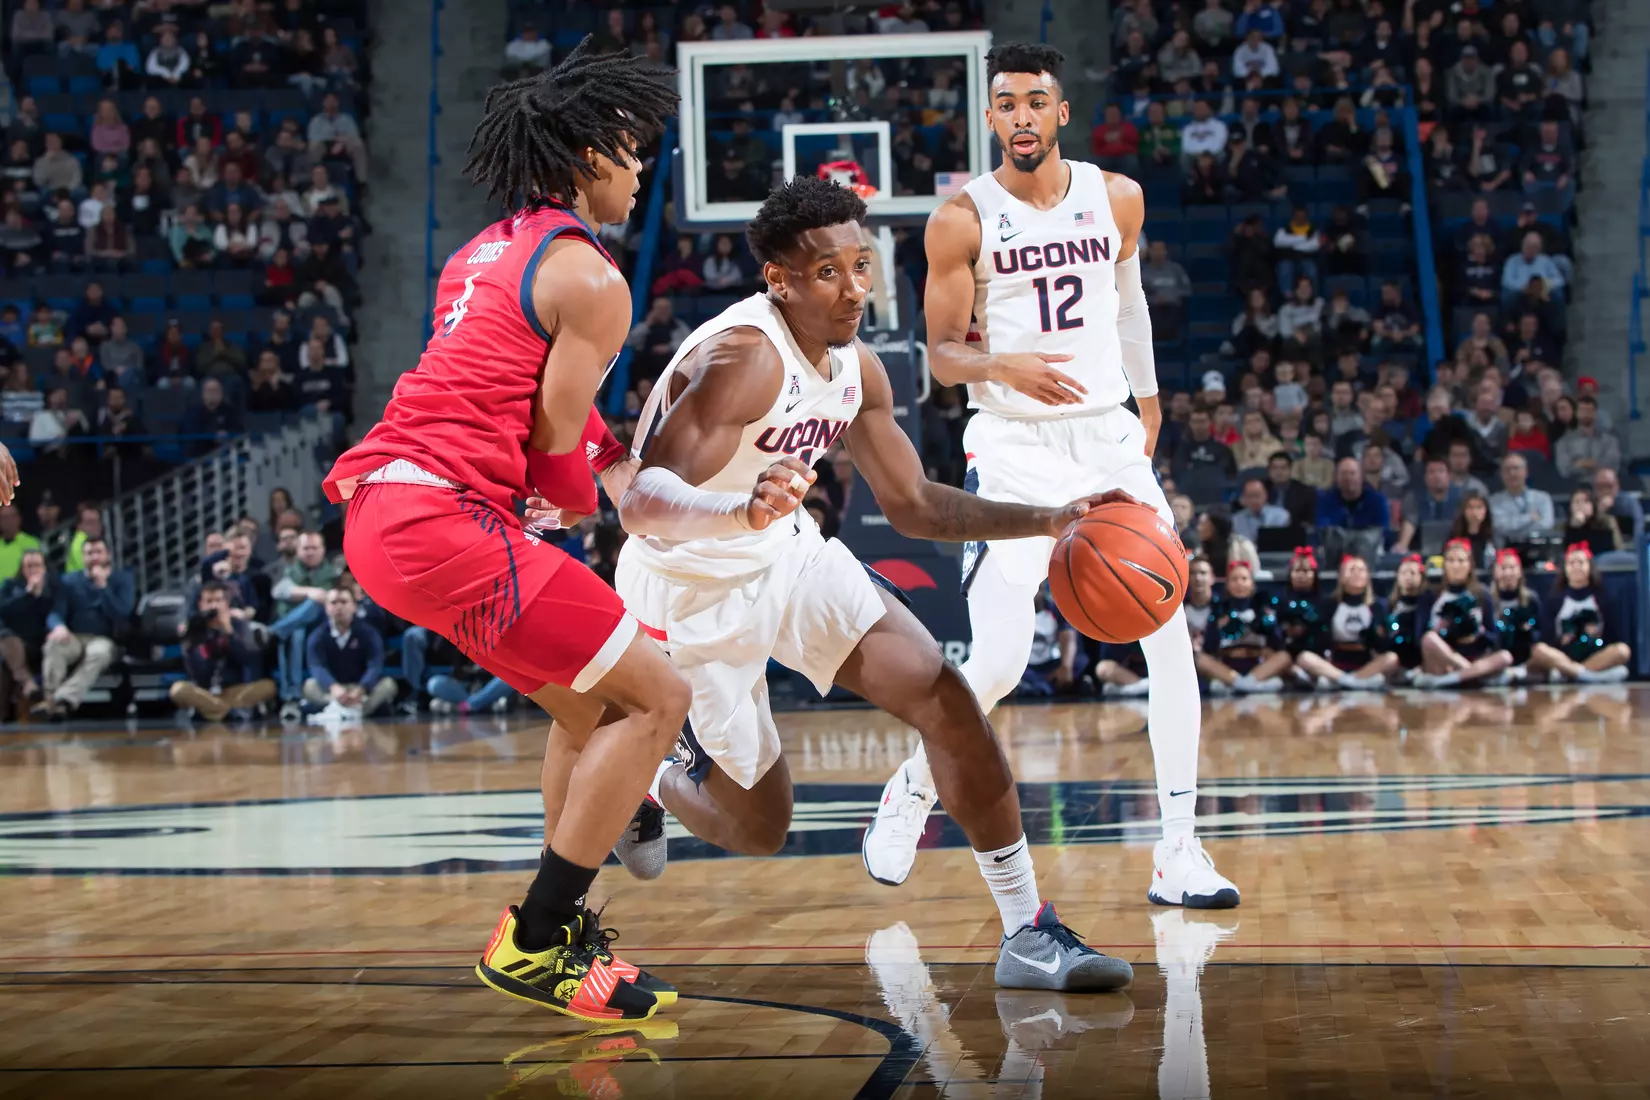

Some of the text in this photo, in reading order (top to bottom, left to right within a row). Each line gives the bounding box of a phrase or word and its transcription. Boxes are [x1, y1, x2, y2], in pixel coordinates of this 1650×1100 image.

[993, 236, 1110, 275] UCONN
[443, 271, 482, 336] 4
[1032, 275, 1084, 333] 12
